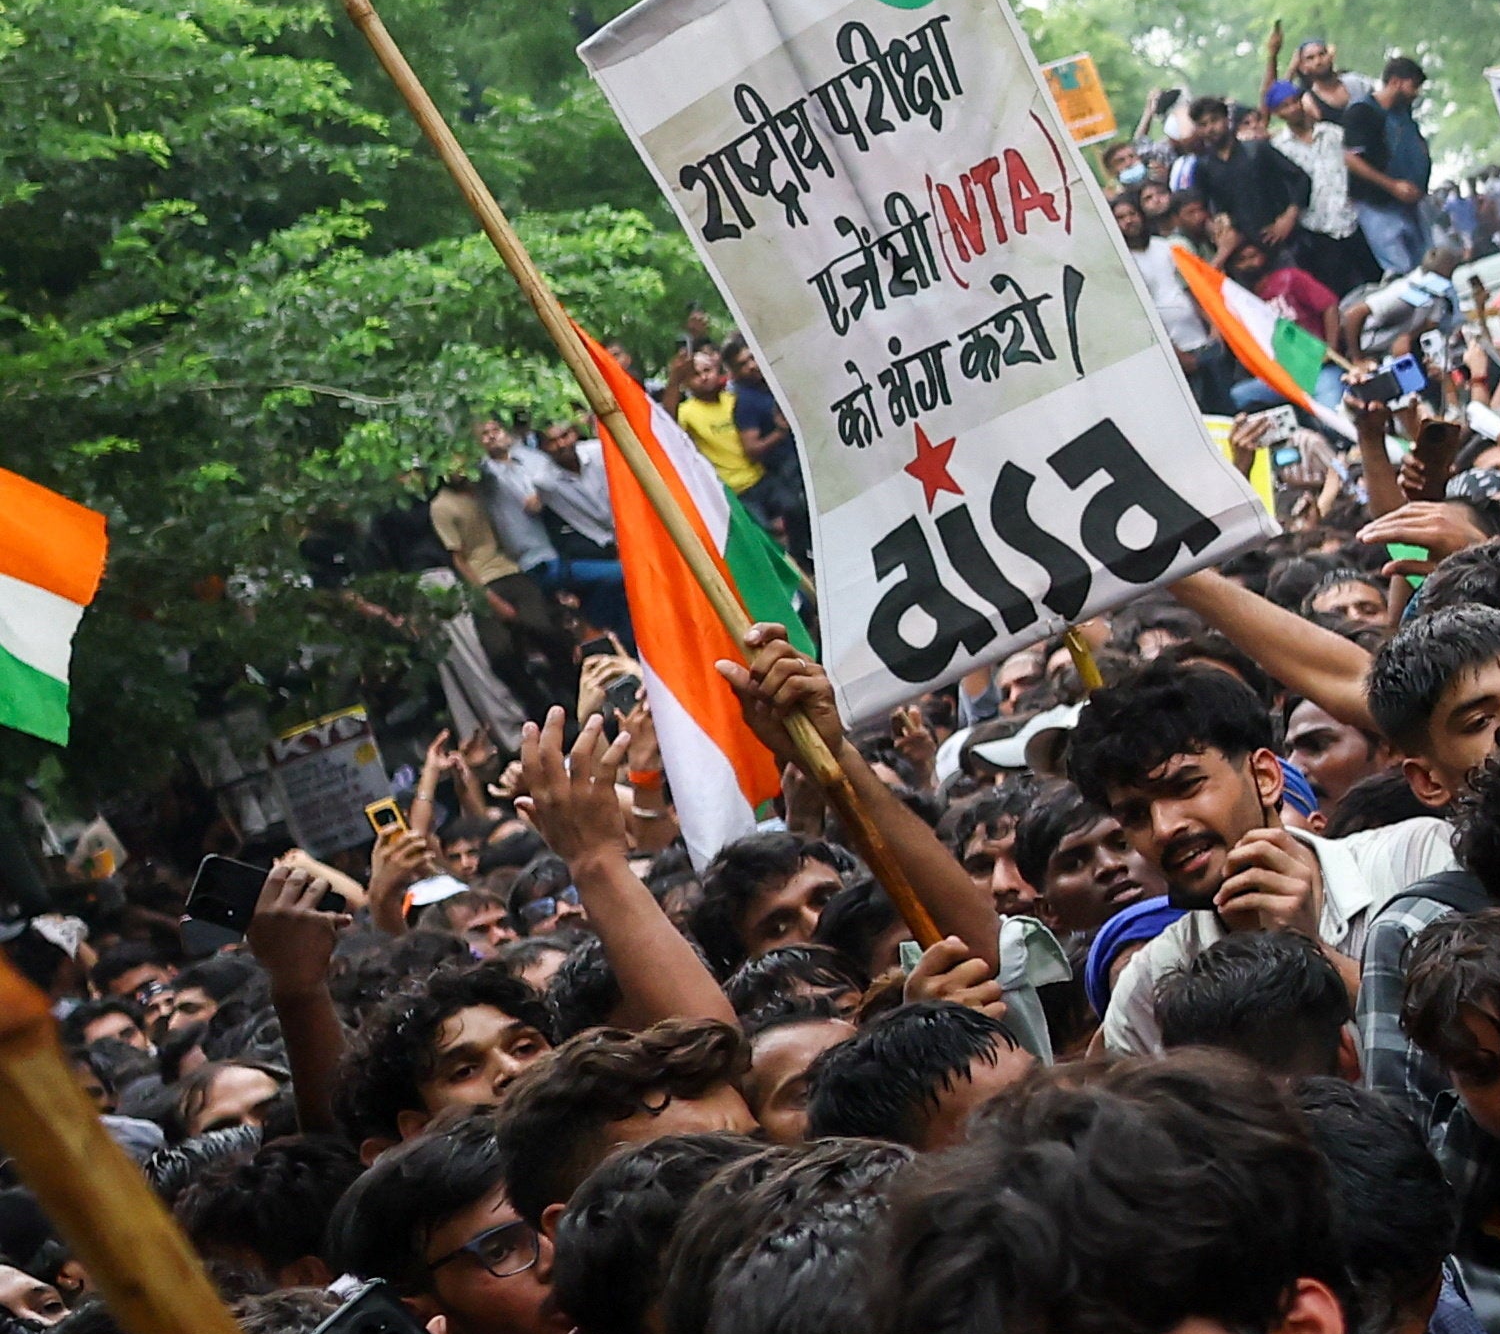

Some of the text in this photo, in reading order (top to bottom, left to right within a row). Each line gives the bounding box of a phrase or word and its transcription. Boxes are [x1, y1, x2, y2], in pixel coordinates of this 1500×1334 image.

[680, 13, 964, 245] राष्ट्रीय परीक्षा
[926, 111, 1074, 289] (NTA)
[831, 361, 881, 448] को
[881, 335, 953, 427] भंग
[866, 417, 1219, 683] aisa
